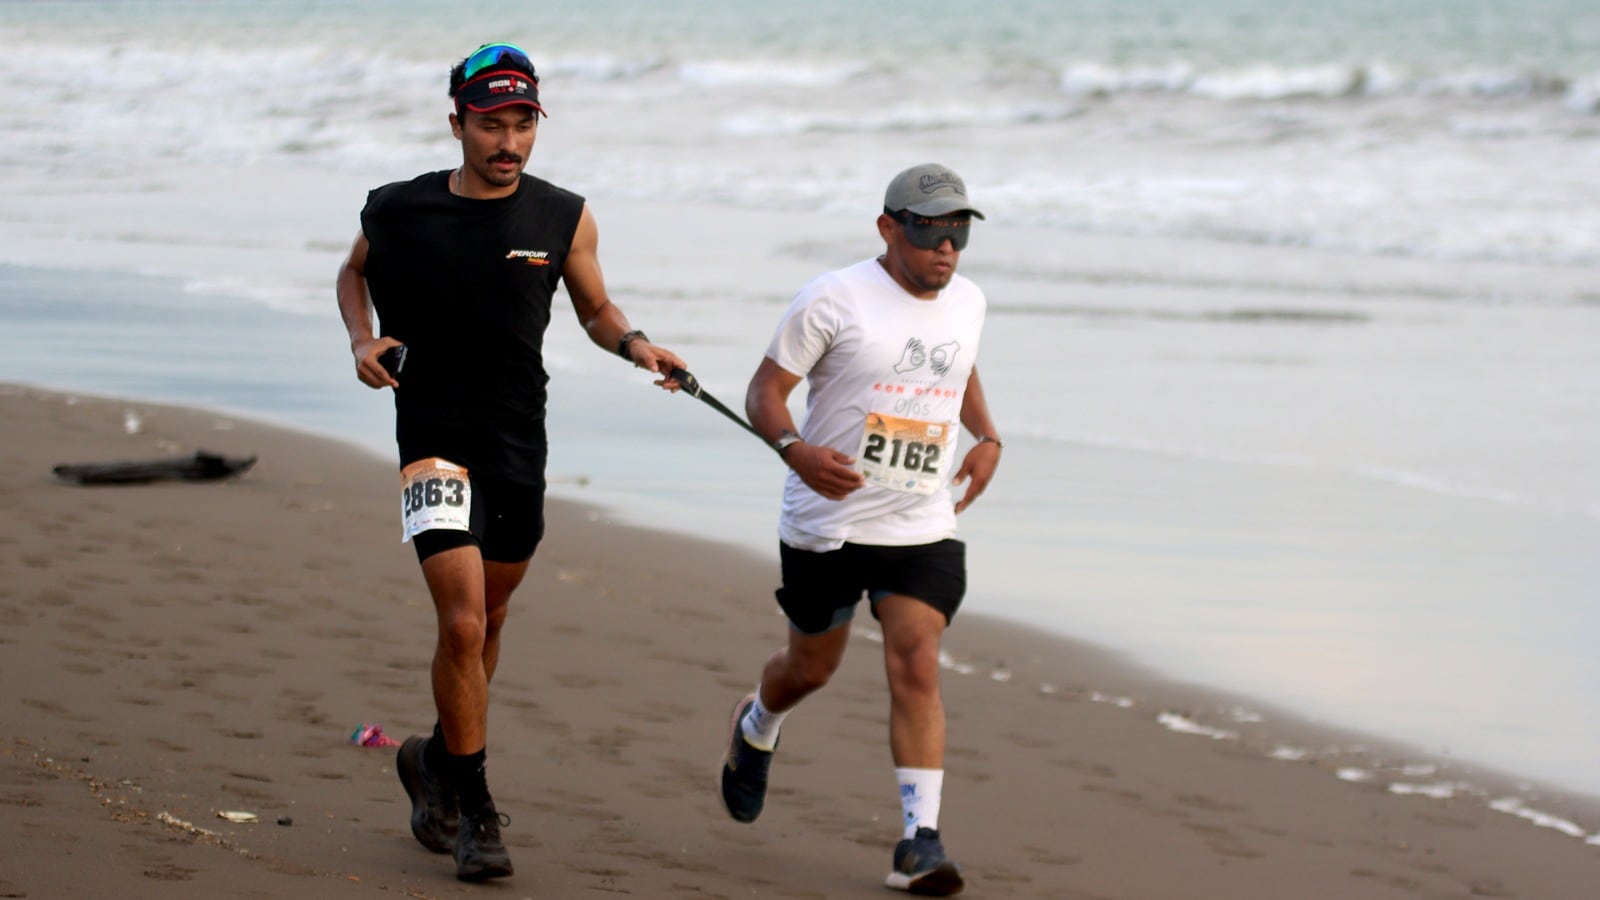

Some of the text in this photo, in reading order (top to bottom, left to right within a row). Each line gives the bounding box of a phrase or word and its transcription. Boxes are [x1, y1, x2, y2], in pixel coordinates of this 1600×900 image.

[505, 250, 549, 259] MERCURY
[874, 383, 905, 394] CON
[863, 433, 941, 475] 2162
[404, 478, 464, 519] 2863
